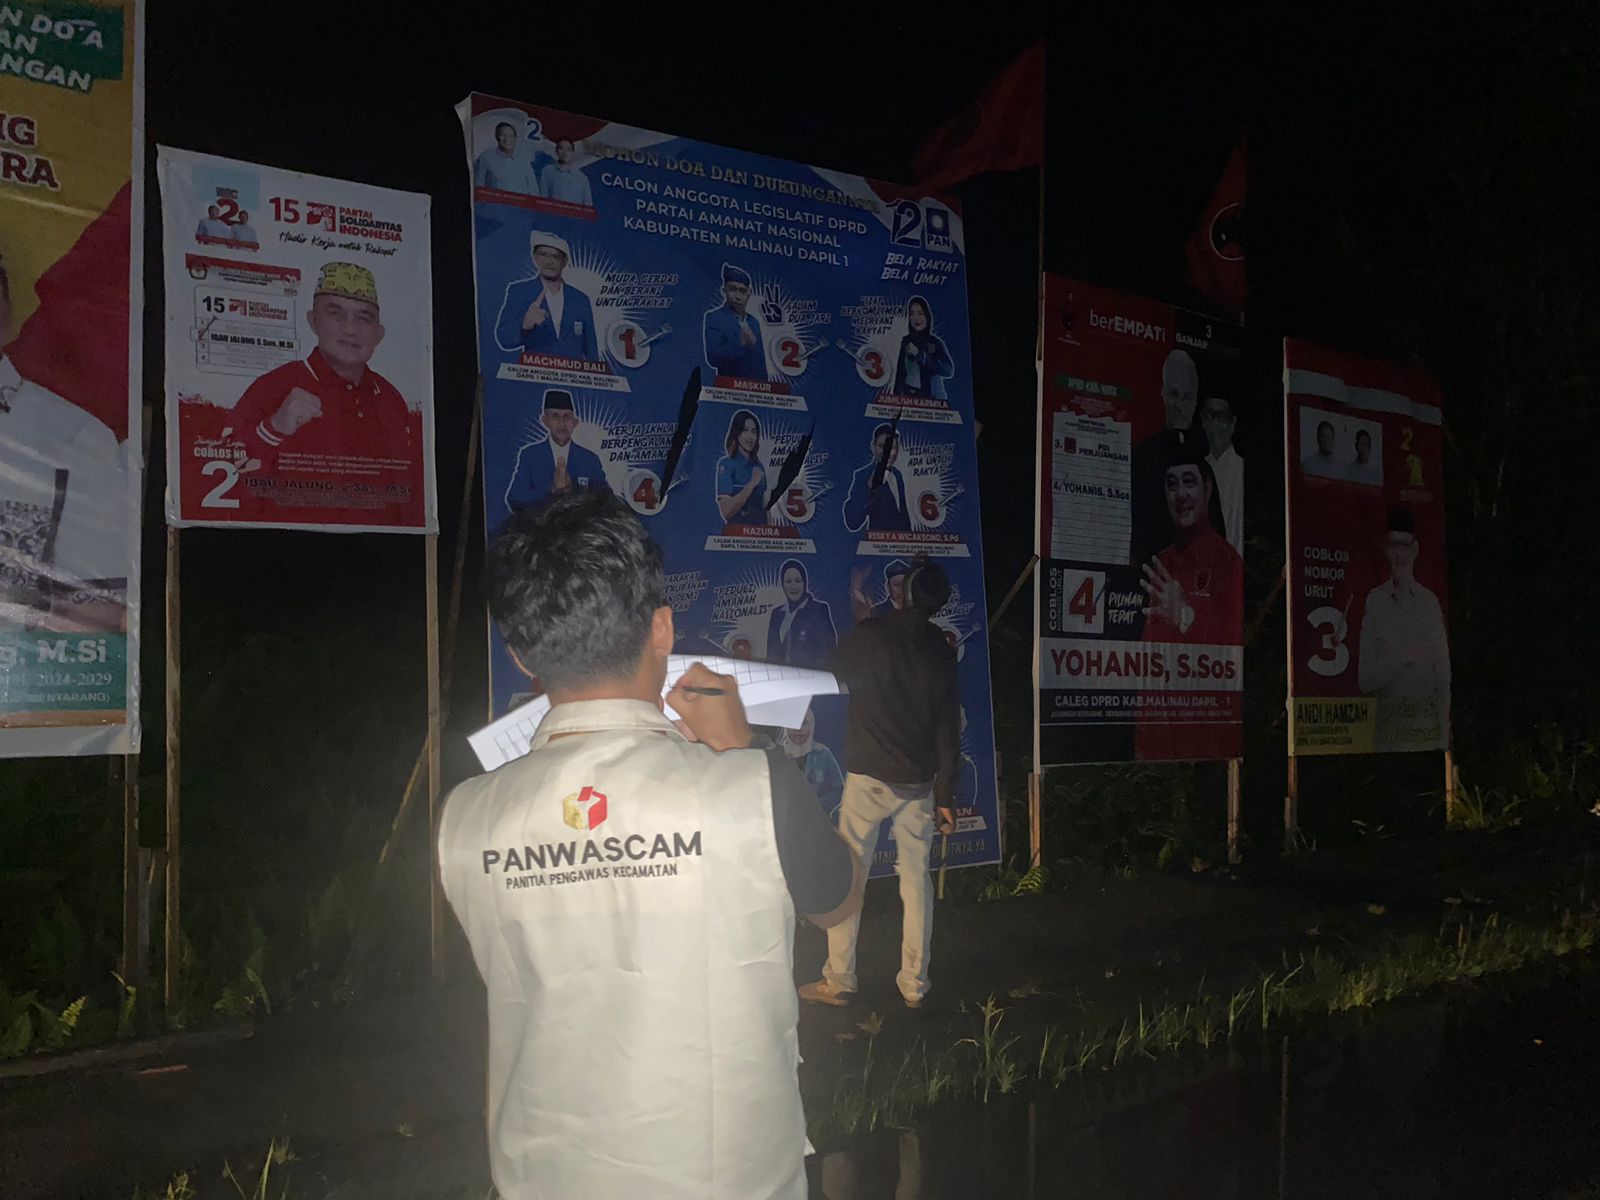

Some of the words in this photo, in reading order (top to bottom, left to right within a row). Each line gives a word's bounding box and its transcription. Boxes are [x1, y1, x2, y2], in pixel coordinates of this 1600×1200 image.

[527, 119, 541, 141] 2
[665, 156, 707, 178] DOA
[711, 165, 748, 186] DAN
[269, 197, 300, 224] 15
[339, 207, 373, 219] PARTAI
[600, 172, 659, 196] CALON
[663, 184, 740, 211] ANGGOTA
[744, 202, 825, 227] LEGISLATIF
[827, 216, 868, 236] DPRD
[339, 215, 403, 233] SOLIDARITAS
[339, 225, 403, 242] INDONESIA
[635, 198, 693, 221] PARTAI
[697, 210, 763, 233] AMANAT
[767, 223, 841, 248] NASIONAL
[892, 199, 922, 248] 2
[927, 234, 951, 248] PAN
[311, 236, 336, 250] Kerja
[623, 216, 721, 244] KABUPATEN
[725, 234, 793, 257] MALINAU
[797, 247, 843, 266] DAPIL
[843, 255, 849, 267] 1
[885, 252, 914, 267] BELA
[916, 256, 960, 273] RAKYAT
[880, 266, 909, 281] BELA
[913, 270, 949, 287] UMAT
[202, 296, 225, 313] 15
[1175, 332, 1209, 350] GANJAR
[1205, 324, 1213, 338] 3
[619, 328, 637, 360] 1
[781, 340, 801, 368] 2
[523, 354, 581, 370] MACHMUD
[583, 363, 606, 373] BALI
[865, 352, 884, 379] 3
[733, 379, 772, 392] MASKUR
[1400, 425, 1415, 451] 2
[194, 447, 232, 459] COBLOS
[634, 449, 670, 461] AMANA
[907, 457, 923, 467] ADA
[1079, 447, 1129, 461] PERJUANGAN
[201, 460, 240, 509] 2
[282, 479, 334, 490] JALUNG
[634, 478, 658, 510] 4
[787, 488, 808, 517] 5
[920, 493, 939, 521] 6
[743, 526, 780, 537] NAZURA
[1304, 546, 1350, 562] COBLOS
[1304, 565, 1345, 580] NOMOR
[665, 581, 707, 593] ERUBAHAN
[1304, 584, 1335, 599] URUT
[714, 594, 756, 608] AMANAH
[1049, 567, 1057, 631] COBLOS
[1069, 576, 1097, 624] 4
[1107, 609, 1138, 625] TEPAT
[37, 639, 108, 664] M.Si
[1306, 605, 1350, 677] 3
[1050, 648, 1171, 683] YOHANIS,
[1177, 653, 1236, 680] S.Sos
[1055, 695, 1089, 707] CALEG
[1091, 695, 1120, 707] DPRD
[482, 830, 702, 874] PANWASCAM
[506, 873, 546, 890] PANITIA
[549, 866, 609, 885] PENGAWAS
[613, 863, 678, 878] KECAMATAN
